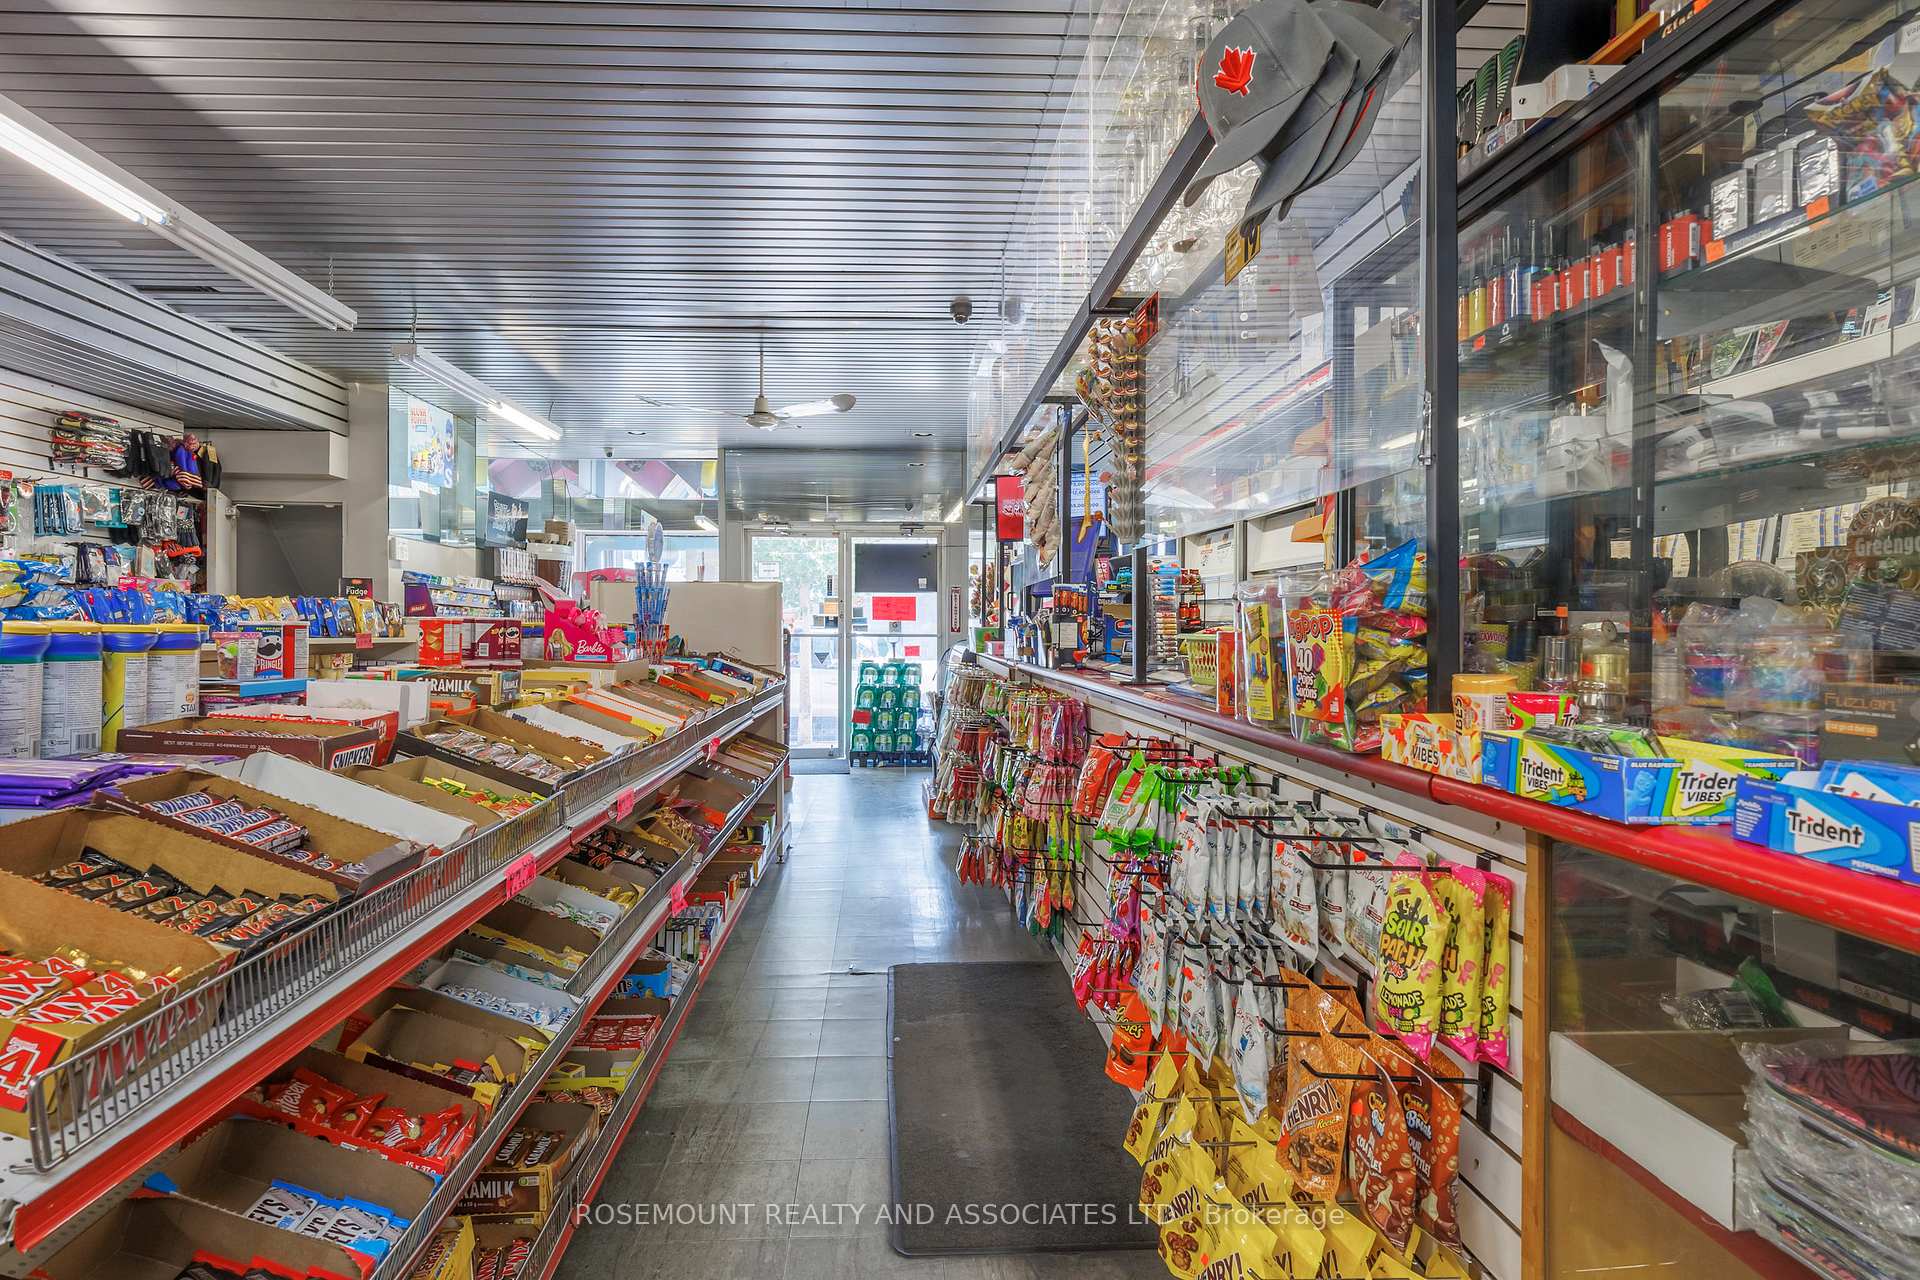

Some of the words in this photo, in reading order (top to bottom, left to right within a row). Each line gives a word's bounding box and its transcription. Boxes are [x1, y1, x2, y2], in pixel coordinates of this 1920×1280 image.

[346, 587, 368, 596] Fudge
[577, 640, 607, 654] Barbie
[1295, 647, 1314, 673] 40
[332, 744, 375, 770] SNICKERS
[1411, 744, 1440, 767] VIBES
[1521, 757, 1565, 783] Trident
[1679, 772, 1737, 790] Triden
[1526, 774, 1549, 791] VIBES
[155, 792, 212, 815] SNICKERS
[1687, 791, 1723, 802] VIBES
[185, 802, 242, 825] SNICKERS
[214, 810, 271, 835] SNICKERS
[1787, 810, 1864, 846] Trident
[1386, 911, 1425, 947] SOUR
[1381, 932, 1428, 971] PATCH
[1380, 987, 1425, 1007] LEMONADE
[1286, 1078, 1342, 1130] HENRY!
[1162, 1186, 1201, 1222] HENRY!
